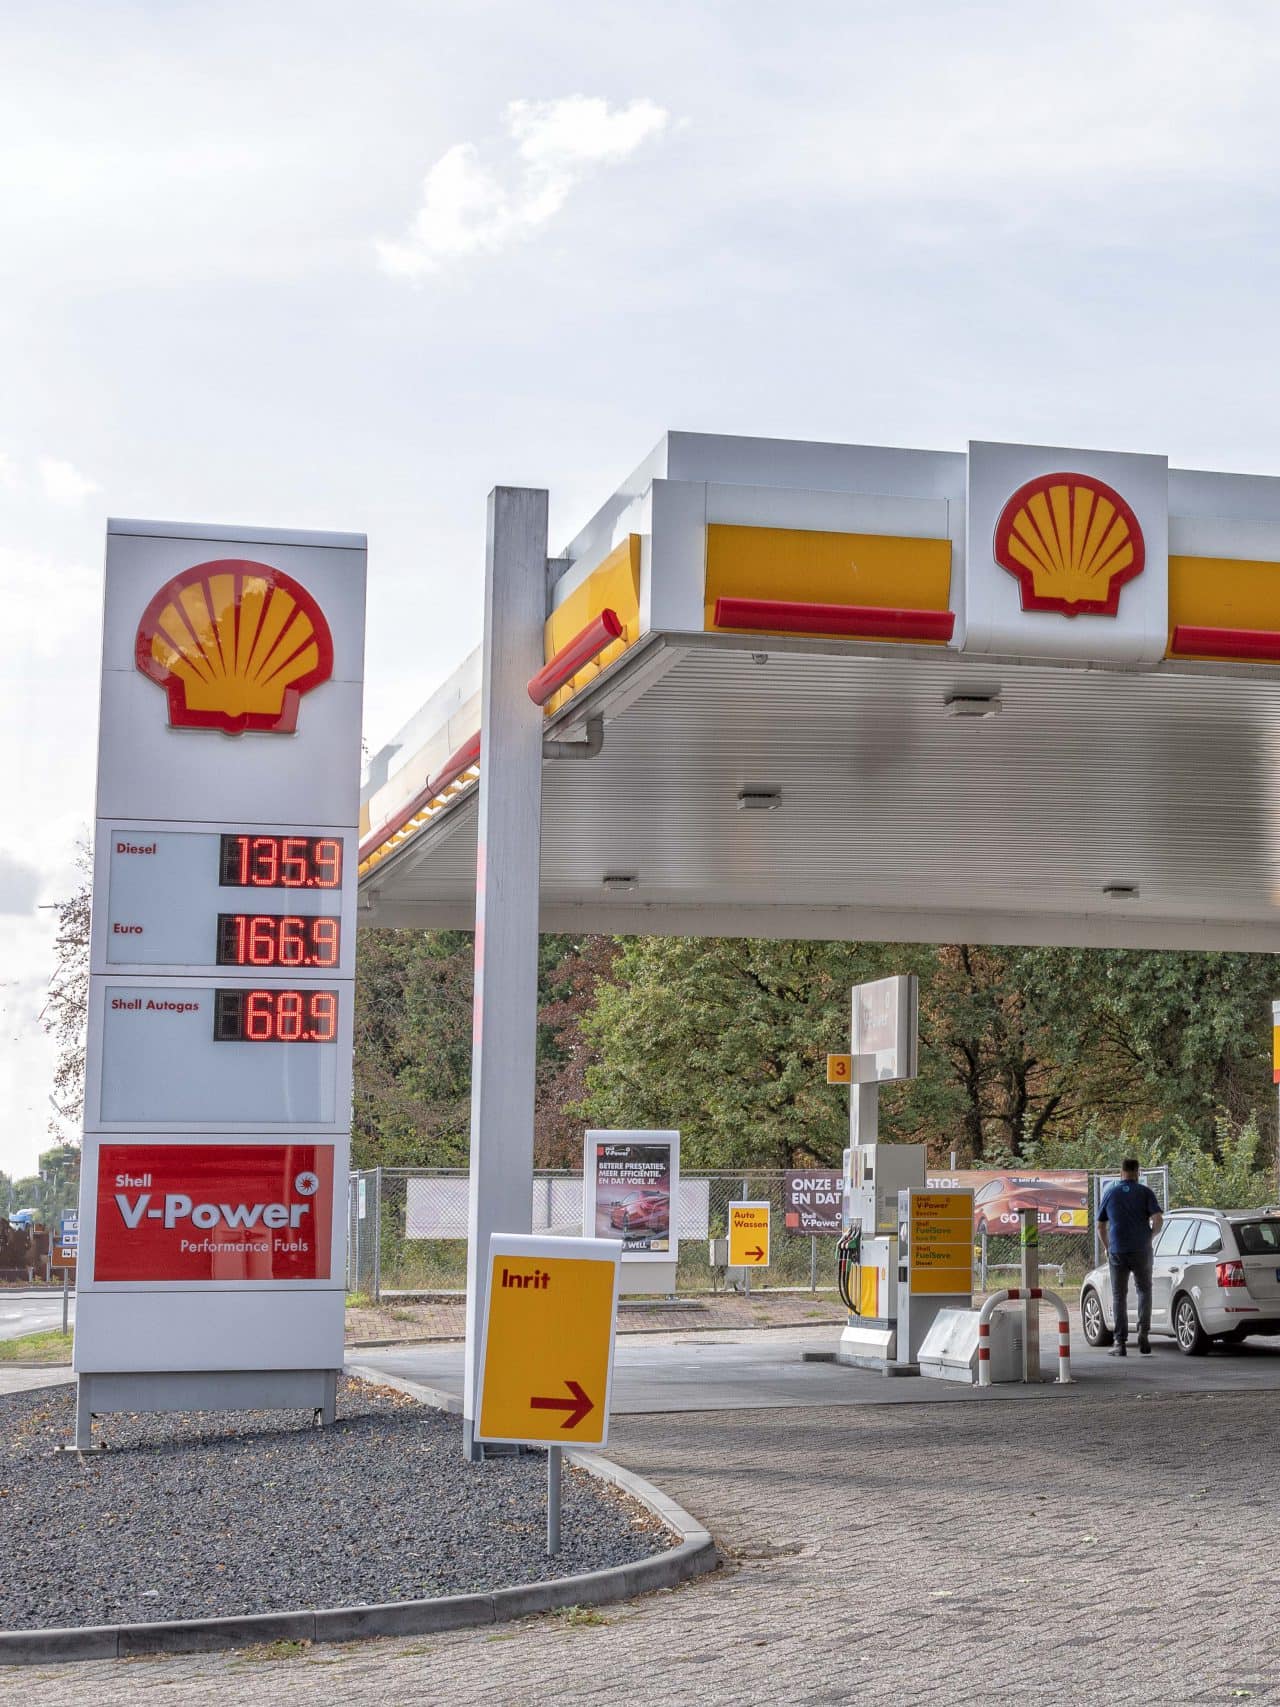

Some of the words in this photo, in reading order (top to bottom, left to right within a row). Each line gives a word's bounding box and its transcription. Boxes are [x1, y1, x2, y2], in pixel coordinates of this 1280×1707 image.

[116, 842, 157, 854] Diesel
[237, 838, 340, 887] 135.9
[113, 923, 143, 934] Euro
[236, 916, 338, 965] 166.9
[111, 999, 142, 1010] Shell
[146, 1000, 199, 1014] Autogas
[247, 992, 336, 1040] 68.9
[835, 1061, 846, 1076] 3
[598, 1162, 624, 1170] BETERE
[115, 1174, 152, 1188] Shell
[791, 1178, 832, 1191] ONZE
[791, 1192, 811, 1205] EN
[815, 1192, 842, 1205] DAT
[916, 1201, 949, 1209] V-Power
[113, 1193, 309, 1229] V-Power
[734, 1211, 755, 1219] Auto
[734, 1219, 768, 1228] Wassen
[801, 1219, 841, 1227] V-Power
[1000, 1212, 1020, 1224] GO
[180, 1239, 269, 1253] Performance
[274, 1239, 309, 1252] Fuels
[628, 1240, 648, 1249] WELL
[502, 1268, 551, 1290] Inrit
